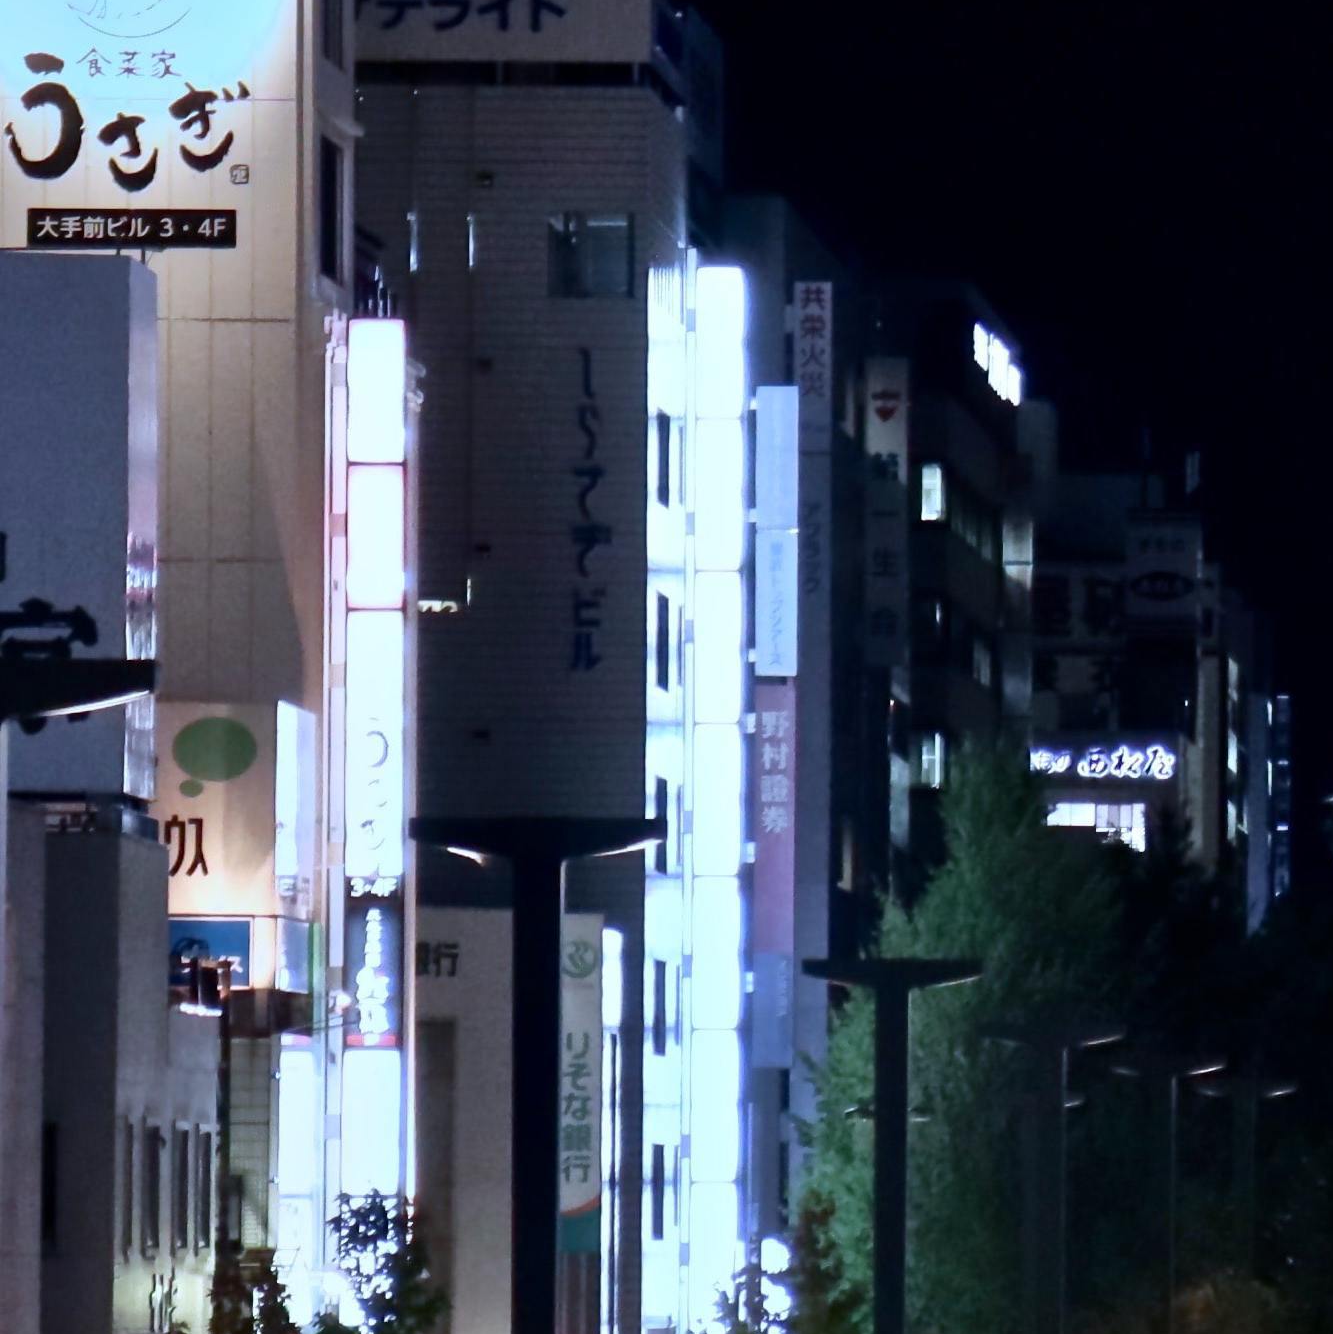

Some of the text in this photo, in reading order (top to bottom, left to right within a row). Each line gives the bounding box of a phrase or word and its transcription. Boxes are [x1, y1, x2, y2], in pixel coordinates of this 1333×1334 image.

[77, 47, 182, 78] 食菜家
[4, 52, 250, 191] うさぎ
[37, 218, 149, 238] 大手前ビル
